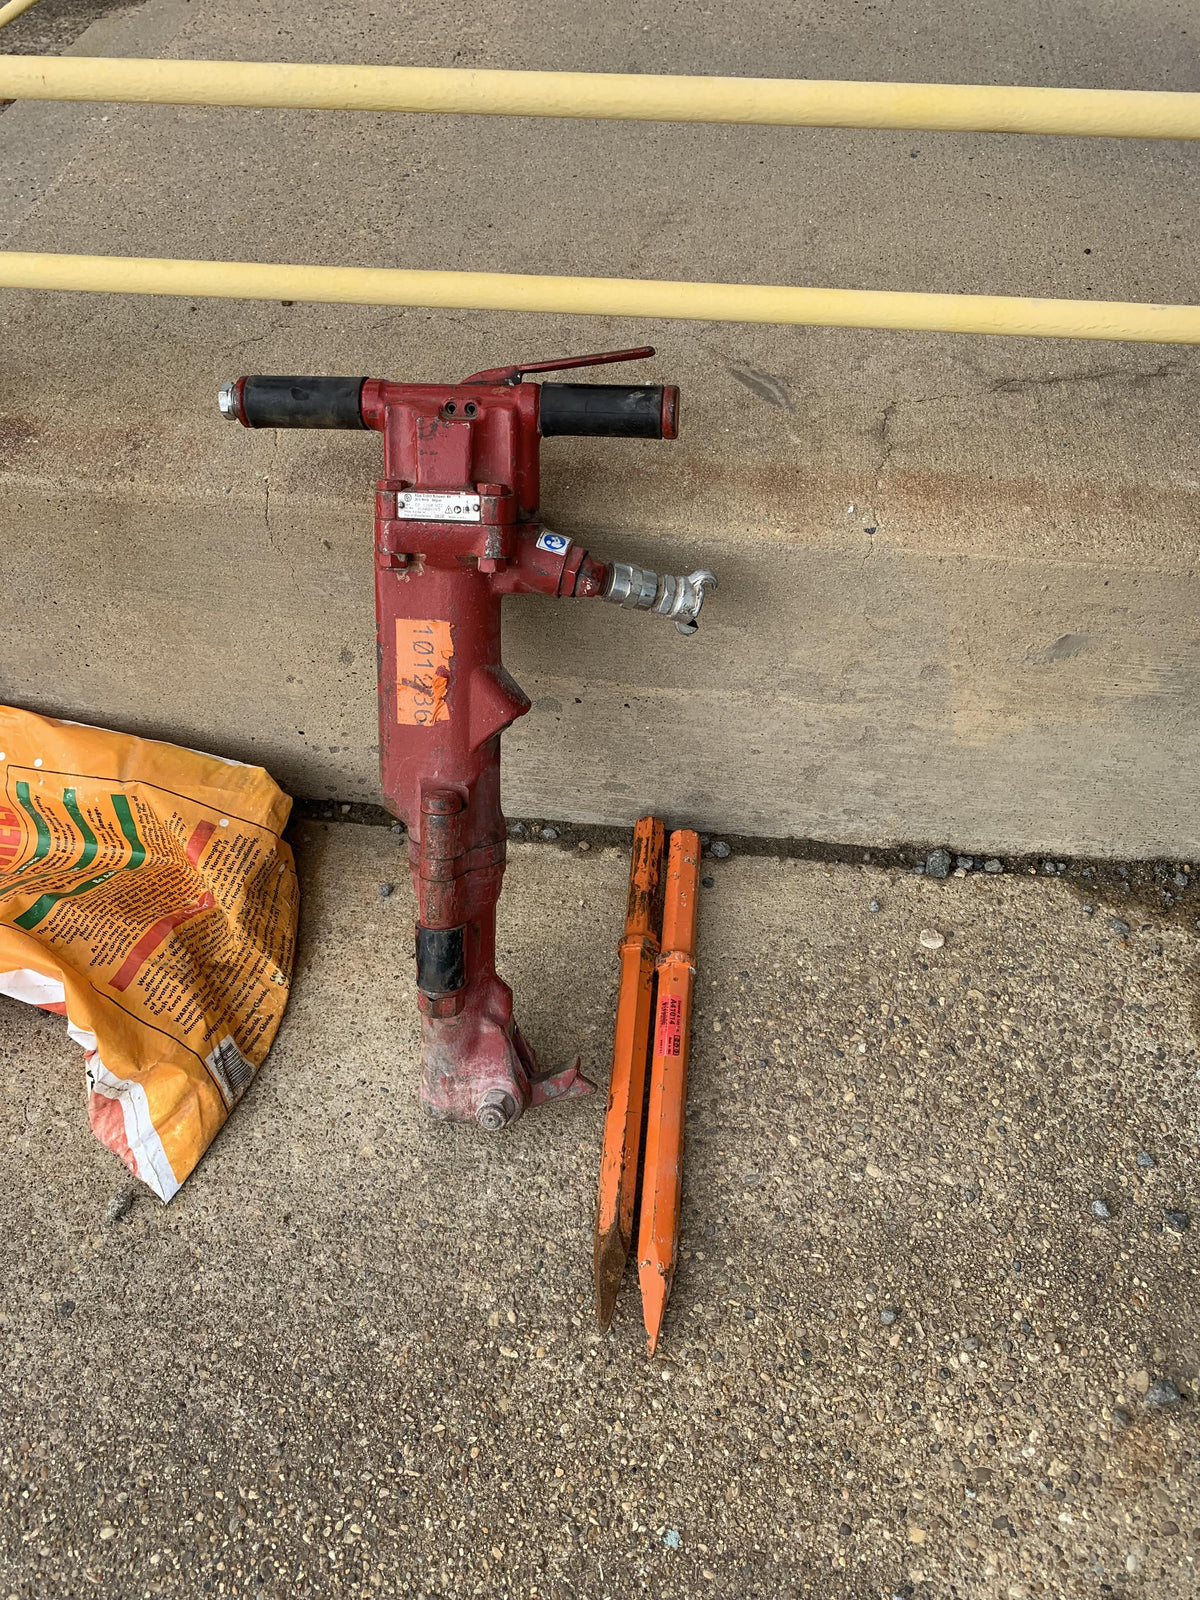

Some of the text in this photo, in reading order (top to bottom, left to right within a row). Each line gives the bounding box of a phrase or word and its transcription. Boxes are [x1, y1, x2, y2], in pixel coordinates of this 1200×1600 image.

[412, 625, 435, 724] 101236
[171, 810, 178, 819] or
[100, 851, 108, 859] in
[209, 844, 227, 871] Harmful
[241, 859, 255, 876] drug
[251, 847, 261, 860] use.
[230, 882, 242, 898] food
[239, 874, 246, 882] or
[36, 924, 49, 936] The
[49, 908, 77, 944] presence of
[49, 921, 60, 933] the
[60, 912, 82, 940] from the
[64, 896, 108, 945] cured and sealed.
[77, 923, 90, 937] that
[88, 912, 99, 924] can
[97, 903, 108, 914] put
[82, 905, 114, 942] freeze/thaw
[90, 943, 99, 953] As
[95, 929, 109, 944] with
[107, 920, 116, 930] all
[114, 913, 123, 922] ice
[91, 917, 111, 940] remove
[109, 908, 120, 919] the
[141, 968, 171, 1006] swallowed.
[212, 866, 224, 884] flush
[220, 852, 232, 867] with
[227, 832, 243, 853] plenty
[148, 1001, 157, 1011] of
[155, 981, 171, 1001] water
[169, 970, 179, 981] for
[221, 873, 229, 881] of
[225, 858, 236, 873] skin
[232, 834, 250, 859] contact,
[88, 940, 109, 967] concrete
[106, 922, 123, 941] steps,
[96, 951, 109, 966] new
[106, 926, 127, 952] concrete
[105, 931, 132, 966] susceptible
[131, 931, 140, 941] an
[136, 967, 152, 987] Wear
[153, 998, 169, 1016] flush
[166, 983, 179, 1000] with
[176, 966, 195, 985] plenty
[179, 983, 190, 994] out
[166, 993, 183, 1012] Keep
[173, 990, 200, 1024] WARNING:
